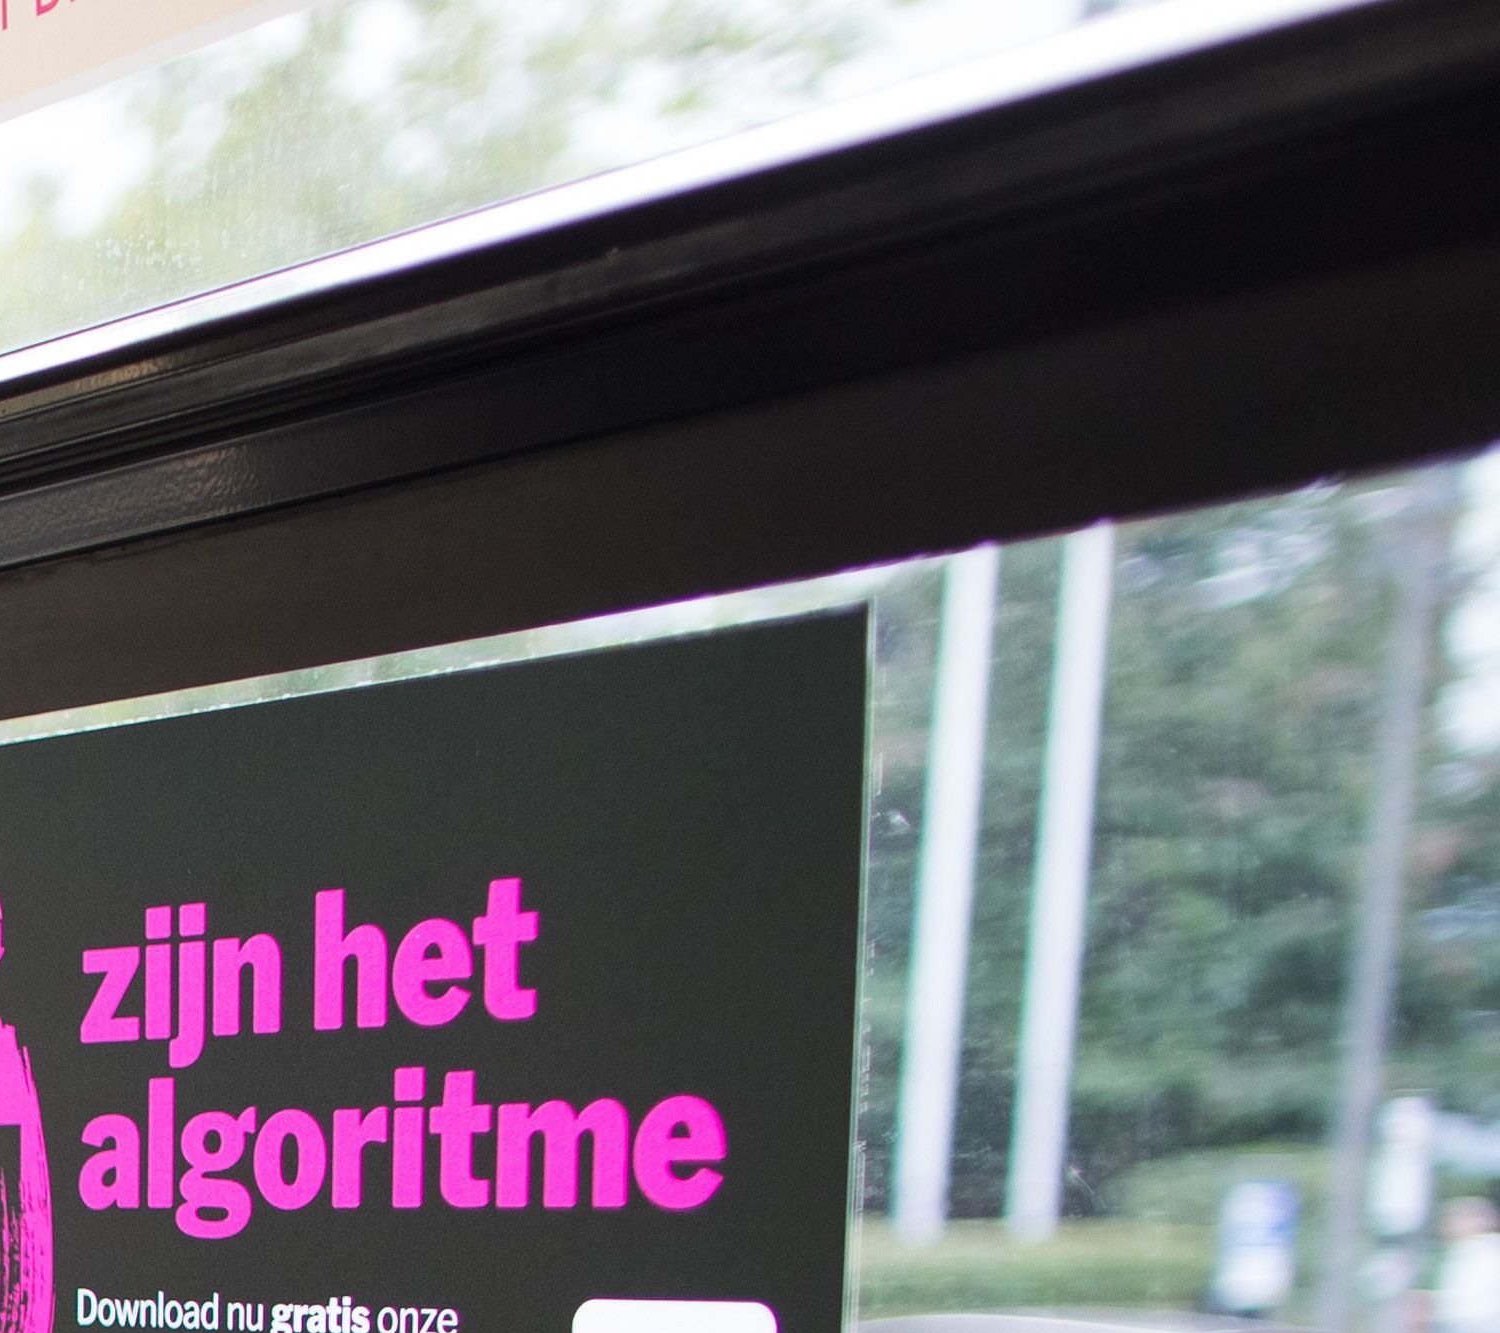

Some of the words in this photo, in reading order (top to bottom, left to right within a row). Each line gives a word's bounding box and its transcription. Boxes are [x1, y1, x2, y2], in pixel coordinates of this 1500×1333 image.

[79, 902, 282, 1068] zijn
[313, 877, 538, 1031] het
[78, 1066, 726, 1240] algoritme
[76, 1288, 219, 1331] Download
[227, 1300, 264, 1332] nu
